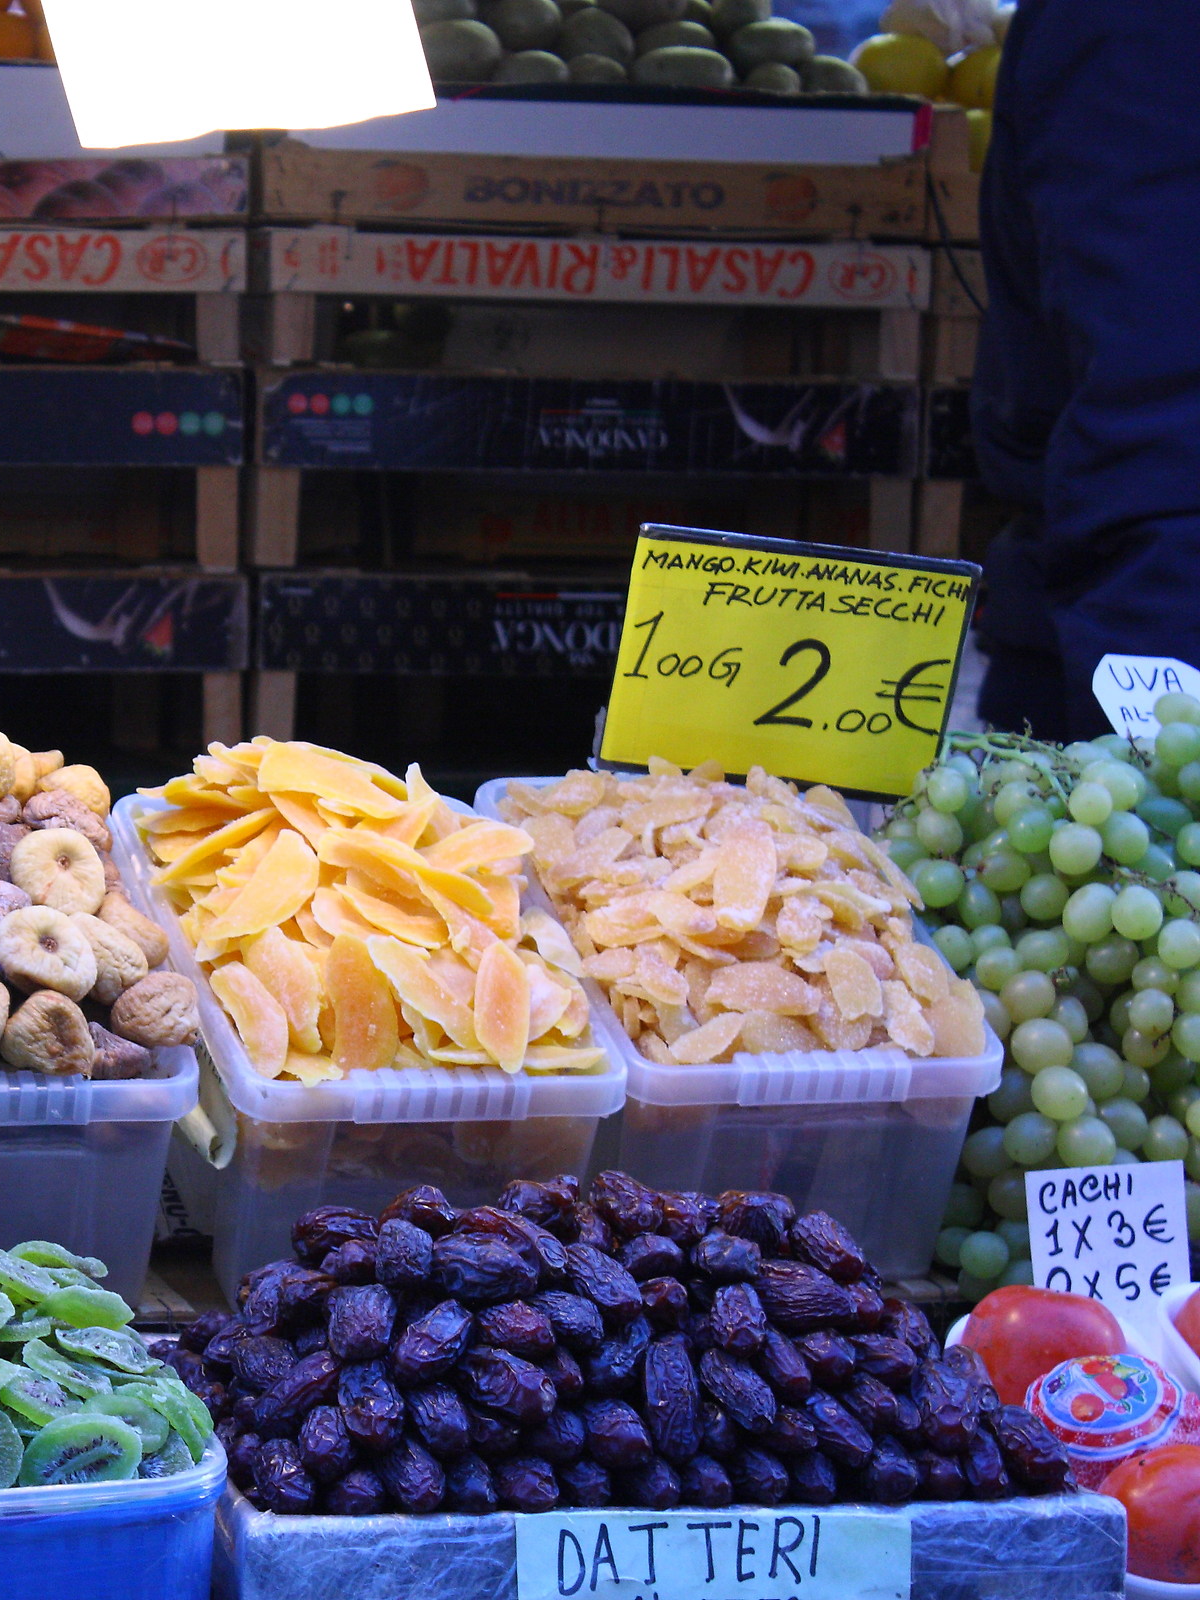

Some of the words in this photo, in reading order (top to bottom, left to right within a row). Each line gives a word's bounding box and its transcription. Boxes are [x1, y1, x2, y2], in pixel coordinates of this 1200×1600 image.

[623, 611, 743, 688] 100G
[1108, 662, 1184, 693] UVA
[1039, 1172, 1133, 1214] CACHI
